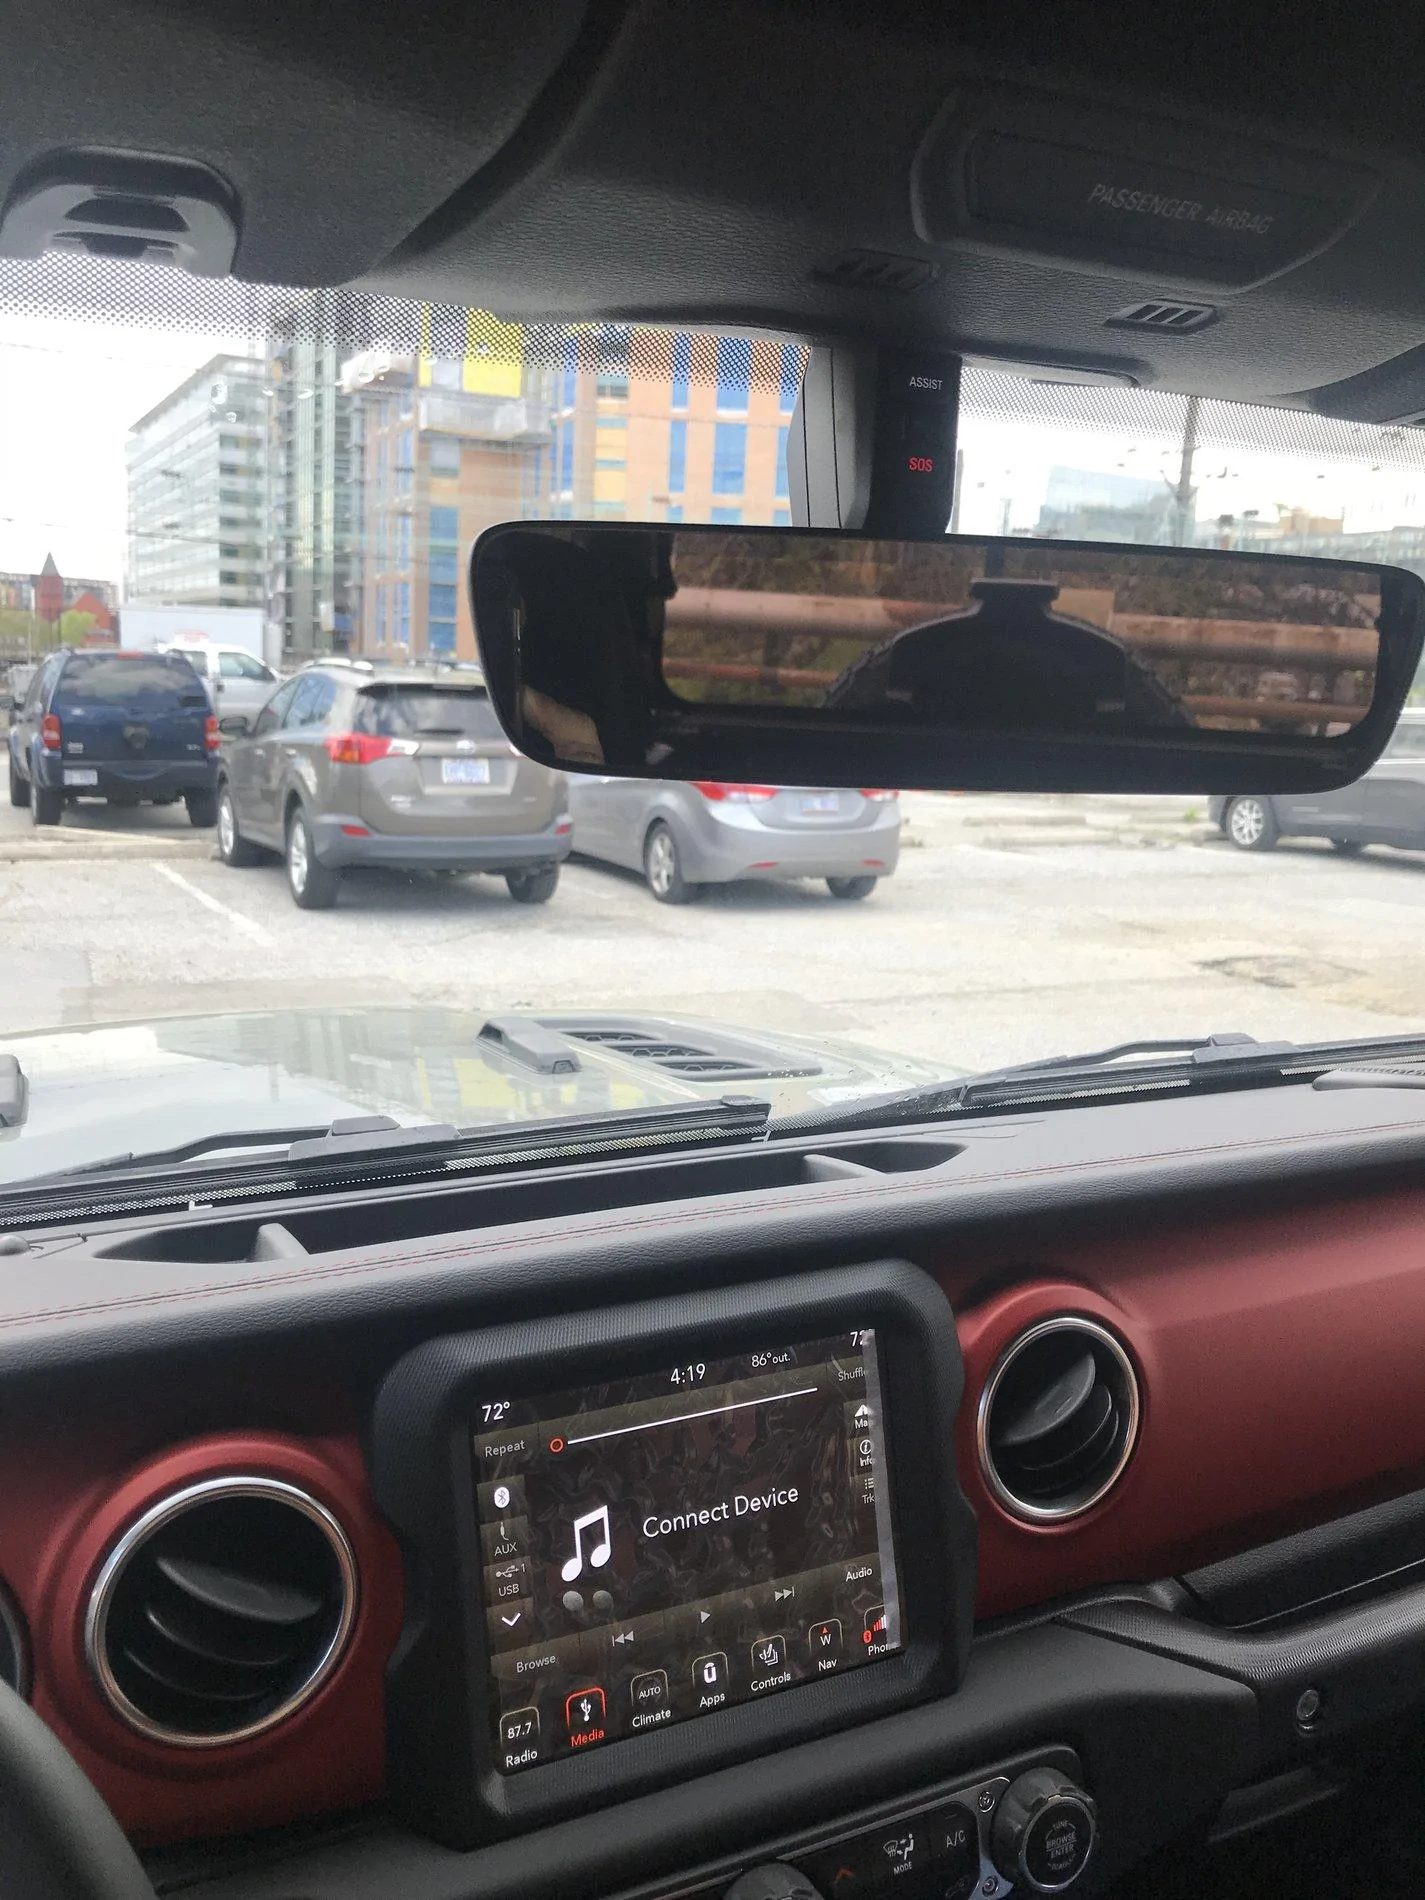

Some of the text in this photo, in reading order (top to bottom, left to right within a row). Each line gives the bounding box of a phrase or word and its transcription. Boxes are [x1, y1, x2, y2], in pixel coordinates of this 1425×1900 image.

[1087, 184, 1274, 233] PASSENGER AIRBAG
[909, 377, 943, 390] ASSIST
[908, 457, 933, 472] SOS
[670, 1363, 706, 1385] 4:19
[838, 1367, 867, 1382] Shuffl
[482, 1401, 510, 1423] 72°
[854, 1419, 869, 1430] Ma
[485, 1440, 525, 1458] Repeat
[862, 1493, 876, 1505] Trk
[643, 1487, 799, 1537] Connect Device
[494, 1542, 517, 1556] AUX
[845, 1567, 873, 1582] Audio
[498, 1583, 520, 1597] USB
[820, 1633, 832, 1646] W
[868, 1644, 888, 1656] Pho
[516, 1655, 556, 1673] Browse
[818, 1658, 837, 1672] Nav
[750, 1671, 791, 1692] Controls
[638, 1686, 661, 1699] AUTO
[699, 1692, 725, 1708] Apps
[632, 1709, 671, 1727] Climate
[507, 1722, 532, 1739] 87.7
[571, 1729, 605, 1747] Media
[505, 1750, 538, 1767] Radio
[946, 1830, 966, 1848] A/C
[893, 1861, 912, 1876] MODE
